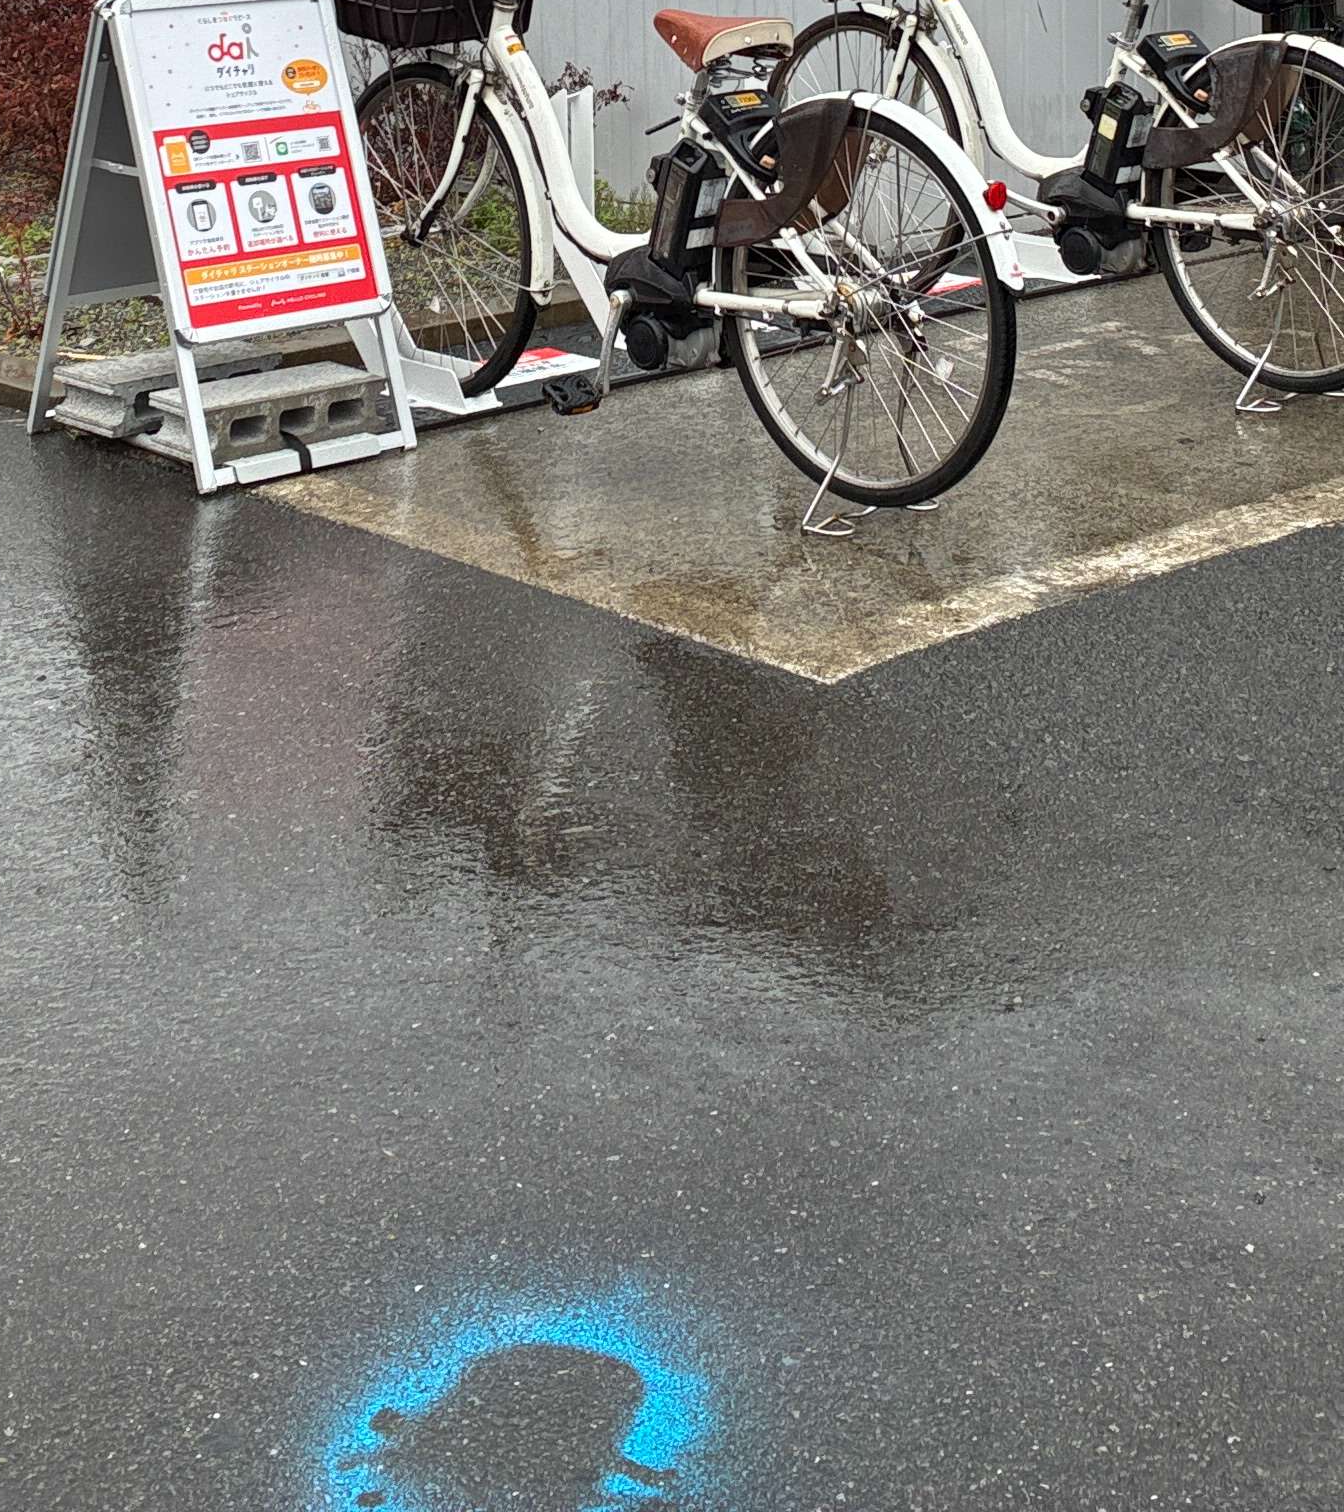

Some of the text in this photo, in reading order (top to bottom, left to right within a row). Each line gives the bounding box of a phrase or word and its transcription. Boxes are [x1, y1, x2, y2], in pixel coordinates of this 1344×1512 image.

[215, 64, 255, 78] ダイチャリ
